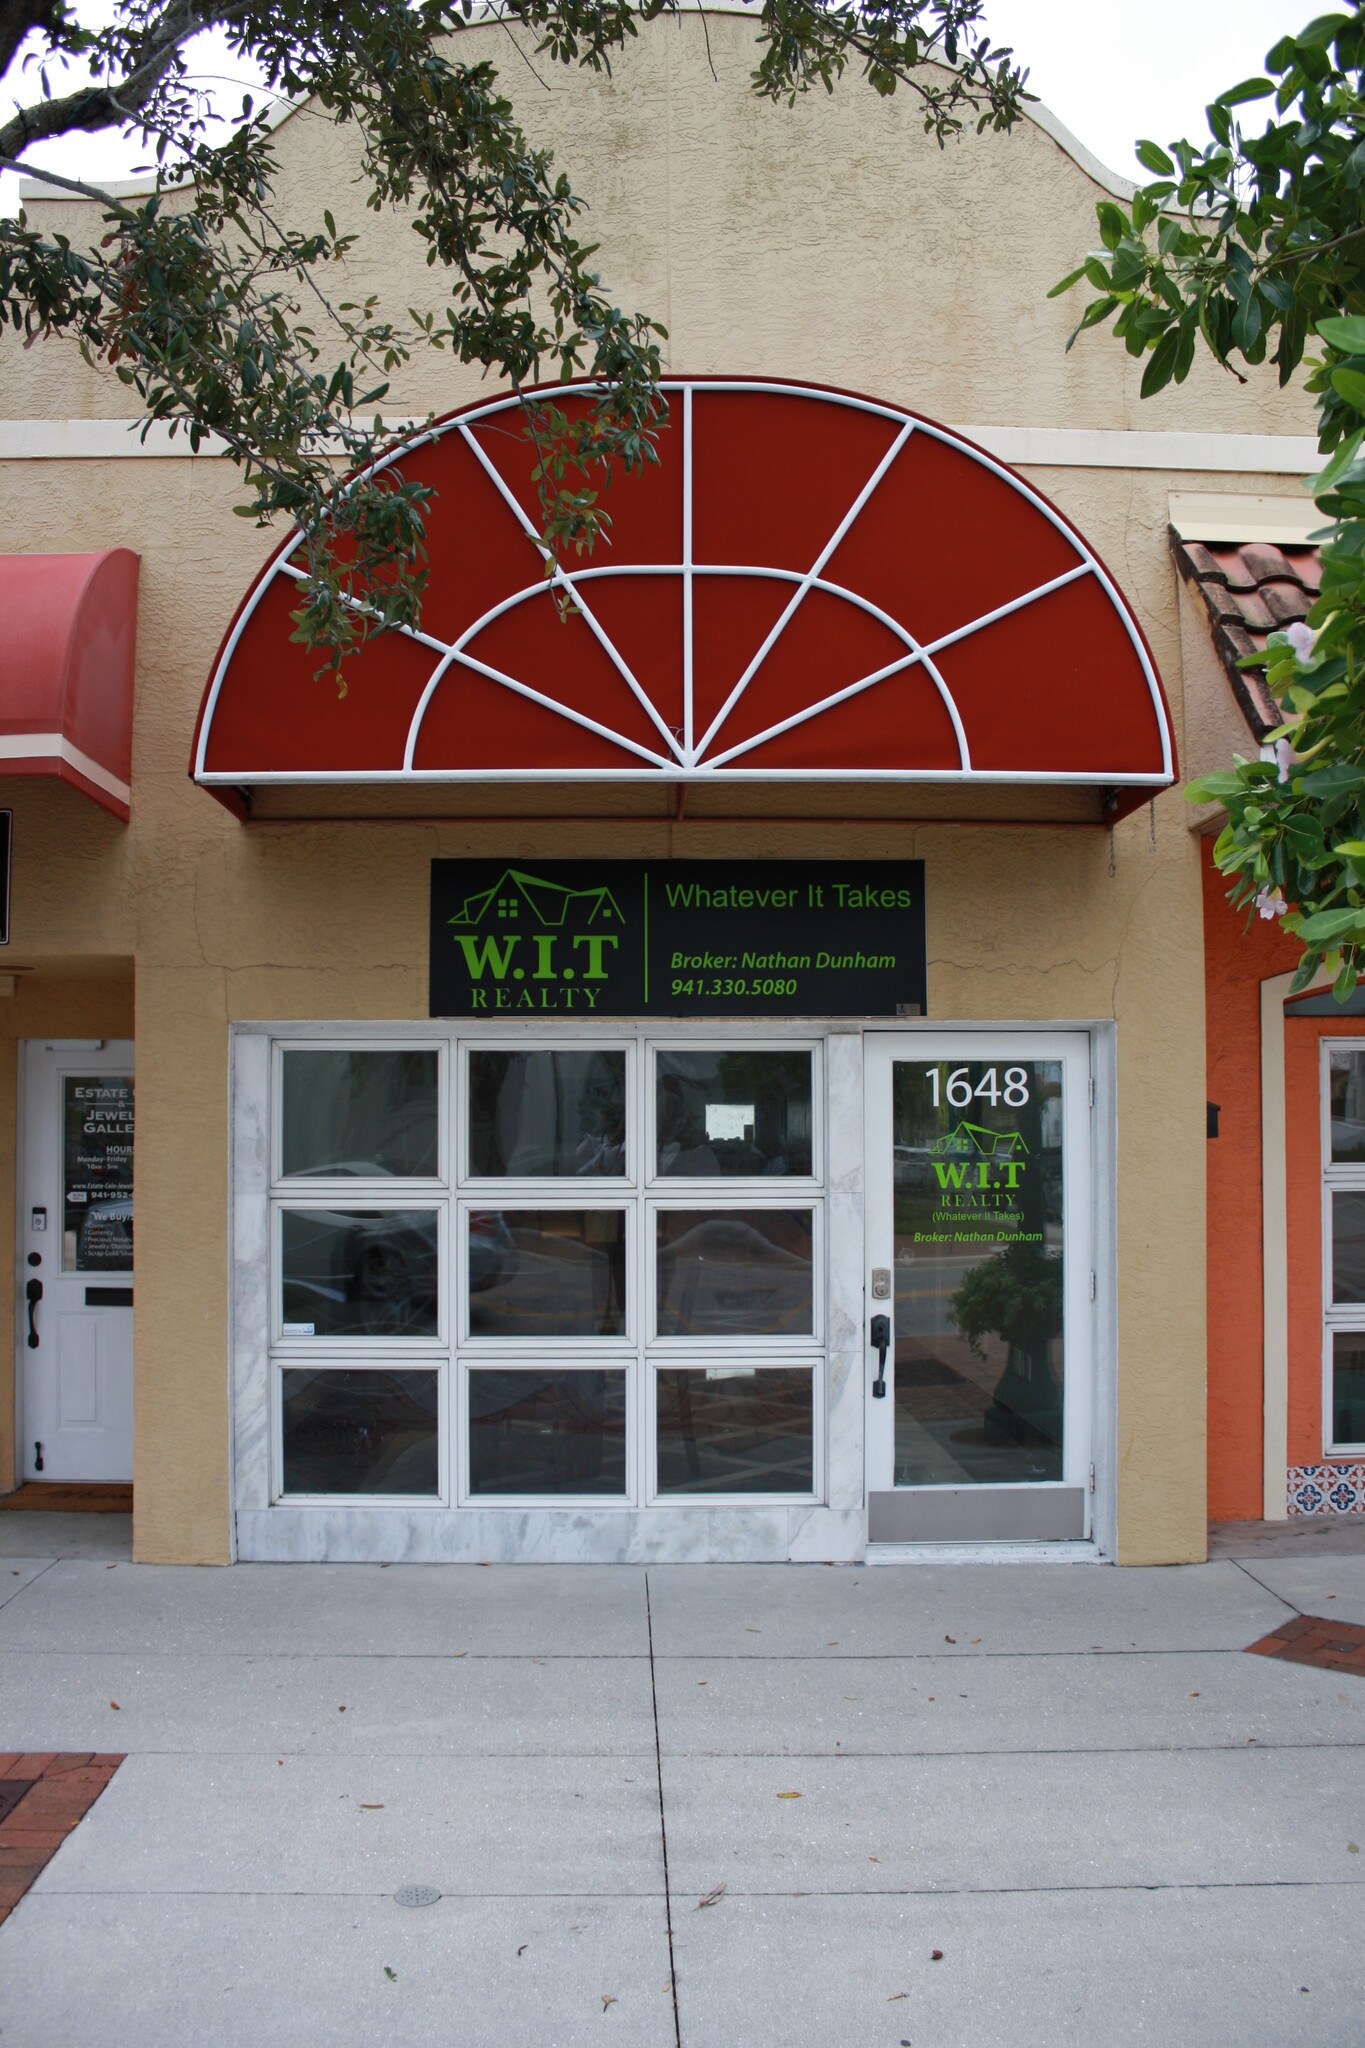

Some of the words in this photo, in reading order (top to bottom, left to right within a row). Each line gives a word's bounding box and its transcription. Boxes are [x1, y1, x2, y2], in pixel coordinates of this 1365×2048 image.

[665, 883, 798, 908] Whatever
[808, 884, 824, 908] It
[832, 884, 911, 908] Takes
[453, 935, 619, 980] W.I.T
[671, 952, 737, 969] Broker:
[741, 952, 811, 969] Nathan
[815, 952, 896, 969] Dunham
[671, 979, 797, 995] 941.330.5080
[471, 988, 601, 1008] REALTY
[75, 1087, 128, 1098] ESTATE
[925, 1067, 1029, 1107] 1648
[931, 1162, 1025, 1189] W.I.T
[941, 1195, 1016, 1207] REALTY
[932, 1211, 981, 1223] (Whatever
[984, 1212, 991, 1221] It
[993, 1211, 1025, 1223] Takes)
[914, 1233, 952, 1242] Broker:
[954, 1232, 994, 1242] Nathan
[996, 1231, 1043, 1242] Dunham
